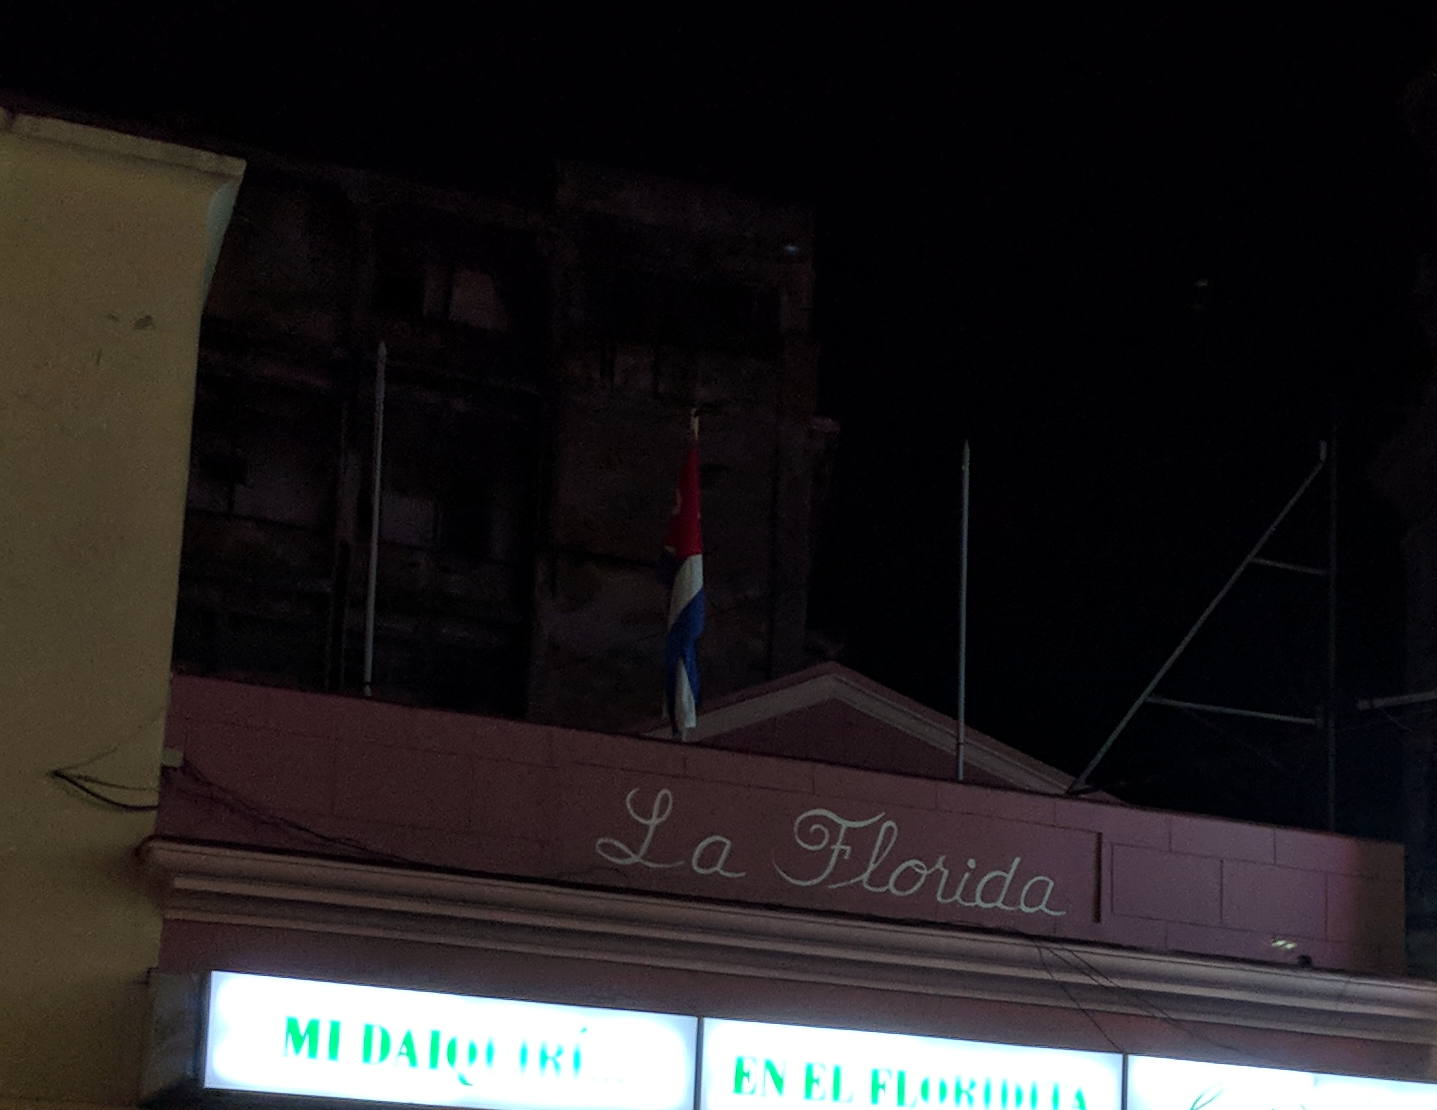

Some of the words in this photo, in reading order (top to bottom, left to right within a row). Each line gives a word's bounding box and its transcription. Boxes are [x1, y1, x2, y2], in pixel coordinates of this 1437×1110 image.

[595, 787, 747, 878] La
[774, 808, 1067, 917] Florida
[283, 1015, 342, 1062] MI
[732, 1055, 787, 1098] EN
[802, 1061, 854, 1104] EL
